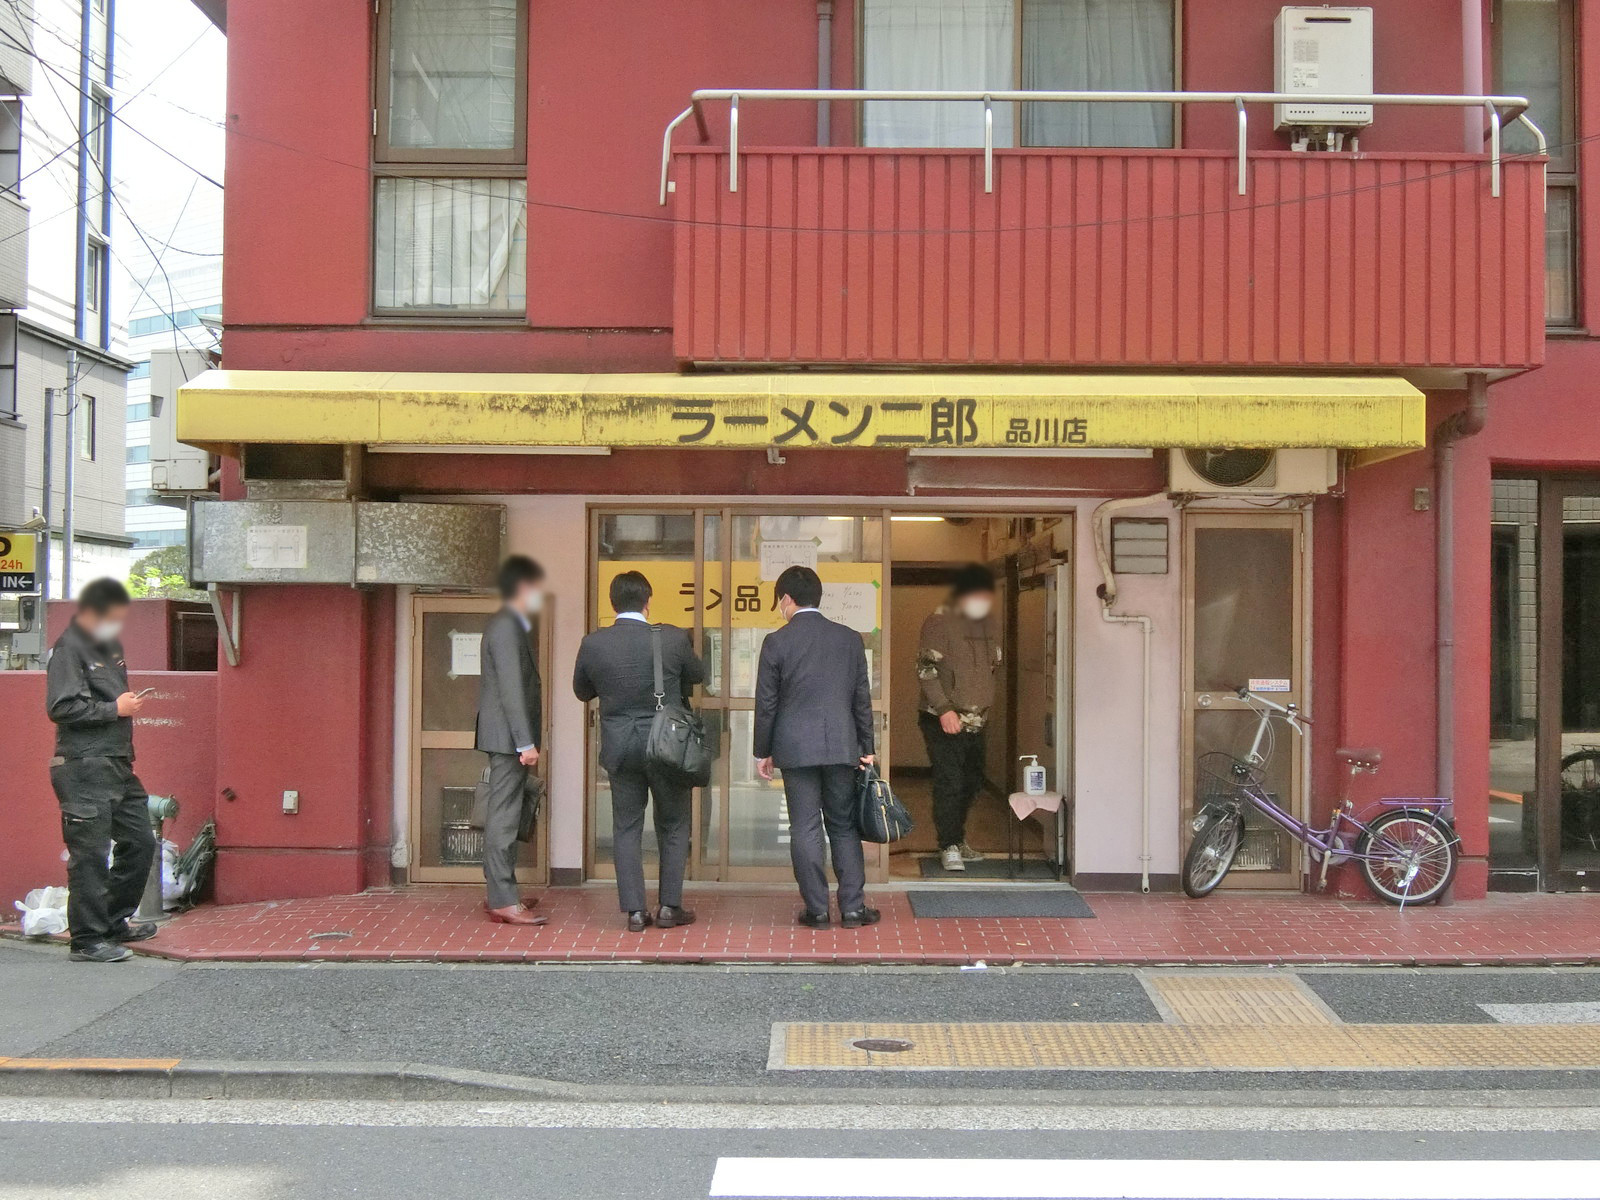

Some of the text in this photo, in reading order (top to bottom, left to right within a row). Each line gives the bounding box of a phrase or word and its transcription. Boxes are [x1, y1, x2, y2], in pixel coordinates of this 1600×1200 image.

[671, 397, 1088, 445] ラーメン二郎 品川店
[0, 559, 23, 570] 24h
[3, 575, 17, 588] IN
